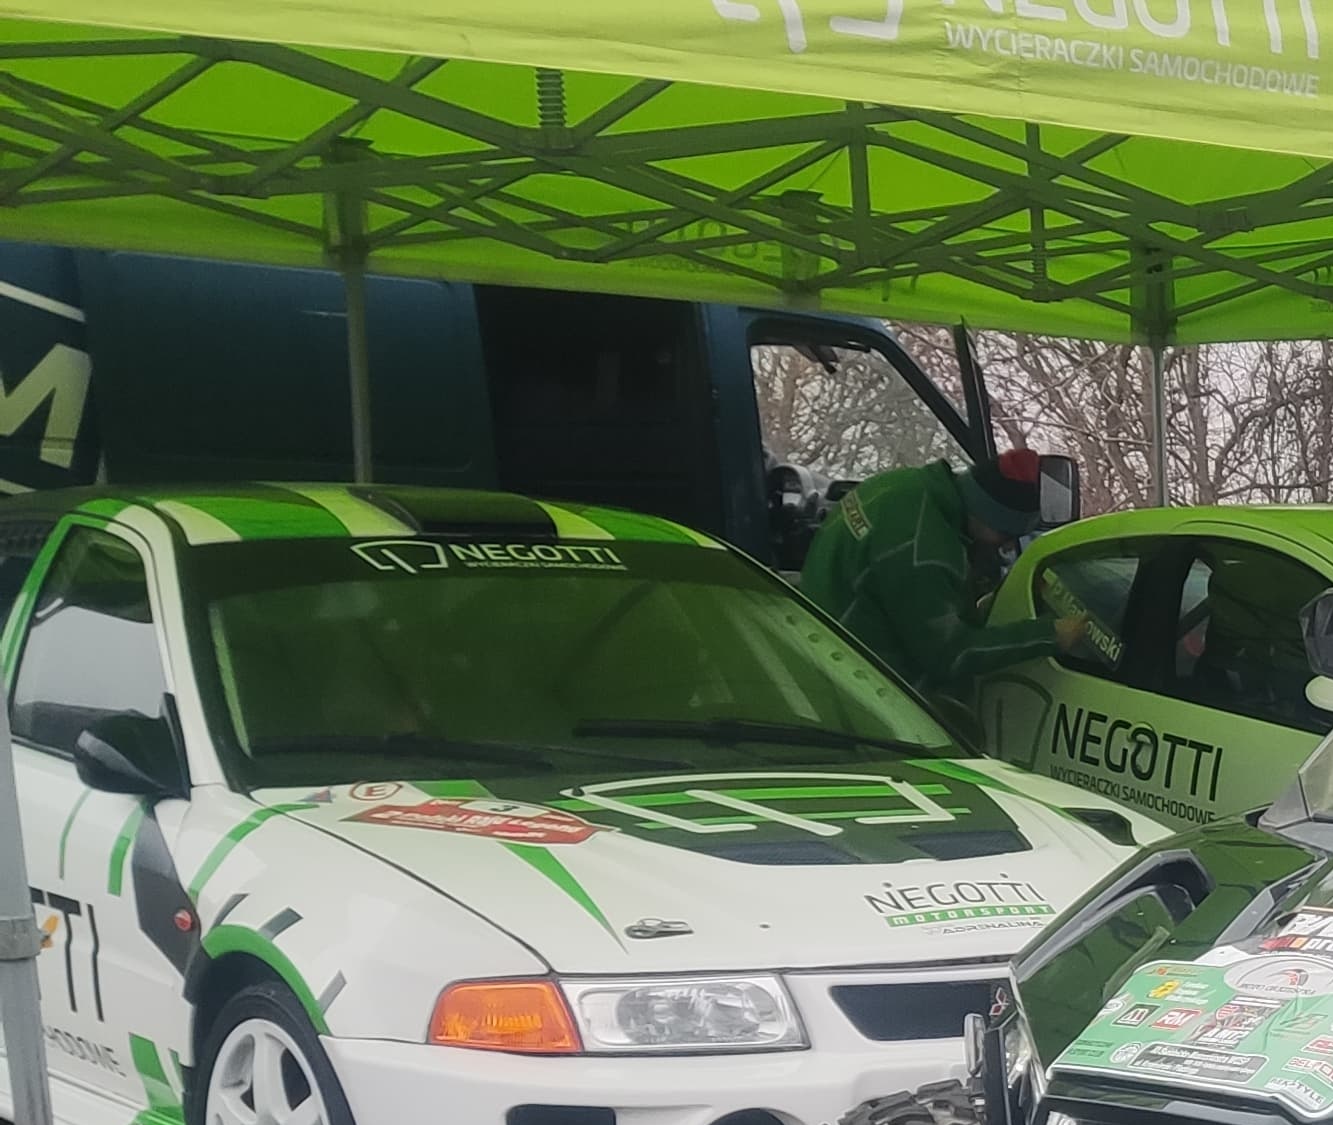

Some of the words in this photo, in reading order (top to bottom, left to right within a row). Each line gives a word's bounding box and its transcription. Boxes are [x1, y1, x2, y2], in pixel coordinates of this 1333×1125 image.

[944, 21, 1124, 69] WYCIERACZKI
[1128, 48, 1321, 98] SAMOCHODOWE
[448, 543, 622, 563] NEGOTTI
[1050, 702, 1224, 803] NEGOTTI
[864, 882, 1046, 914] NEGOTTI
[892, 906, 1051, 925] MOTORSPORT
